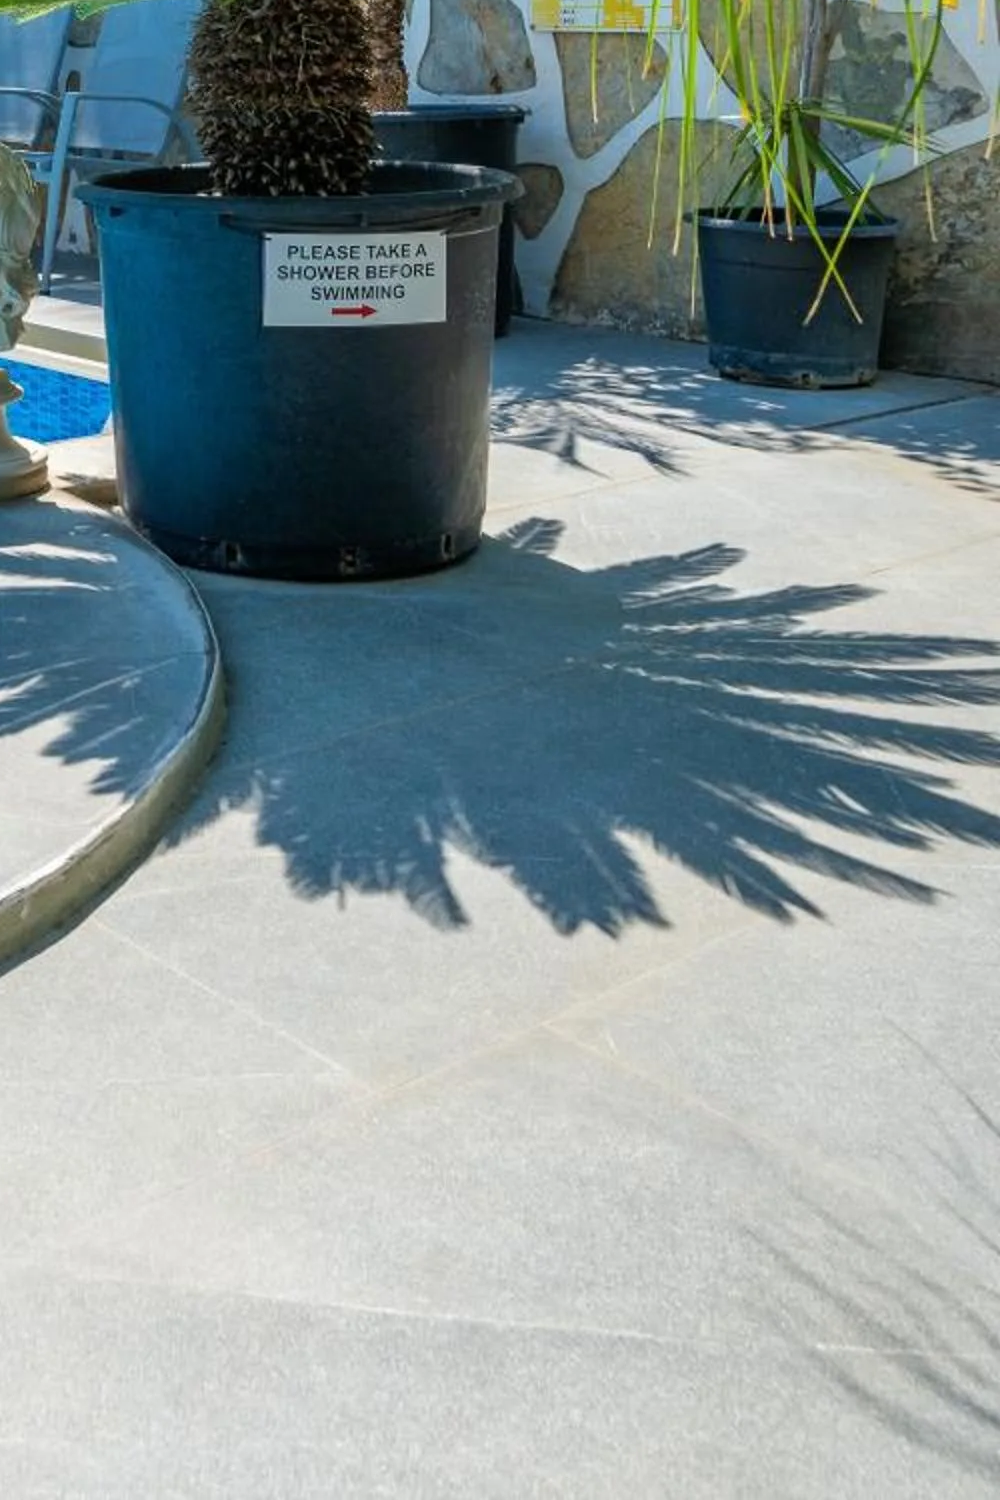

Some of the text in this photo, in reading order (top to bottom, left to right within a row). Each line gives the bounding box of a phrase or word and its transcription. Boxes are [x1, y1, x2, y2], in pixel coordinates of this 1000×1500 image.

[287, 243, 428, 260] PLEASE TAKE A
[277, 262, 435, 280] SHOWER BEFORE
[311, 285, 405, 301] SWIMMING
